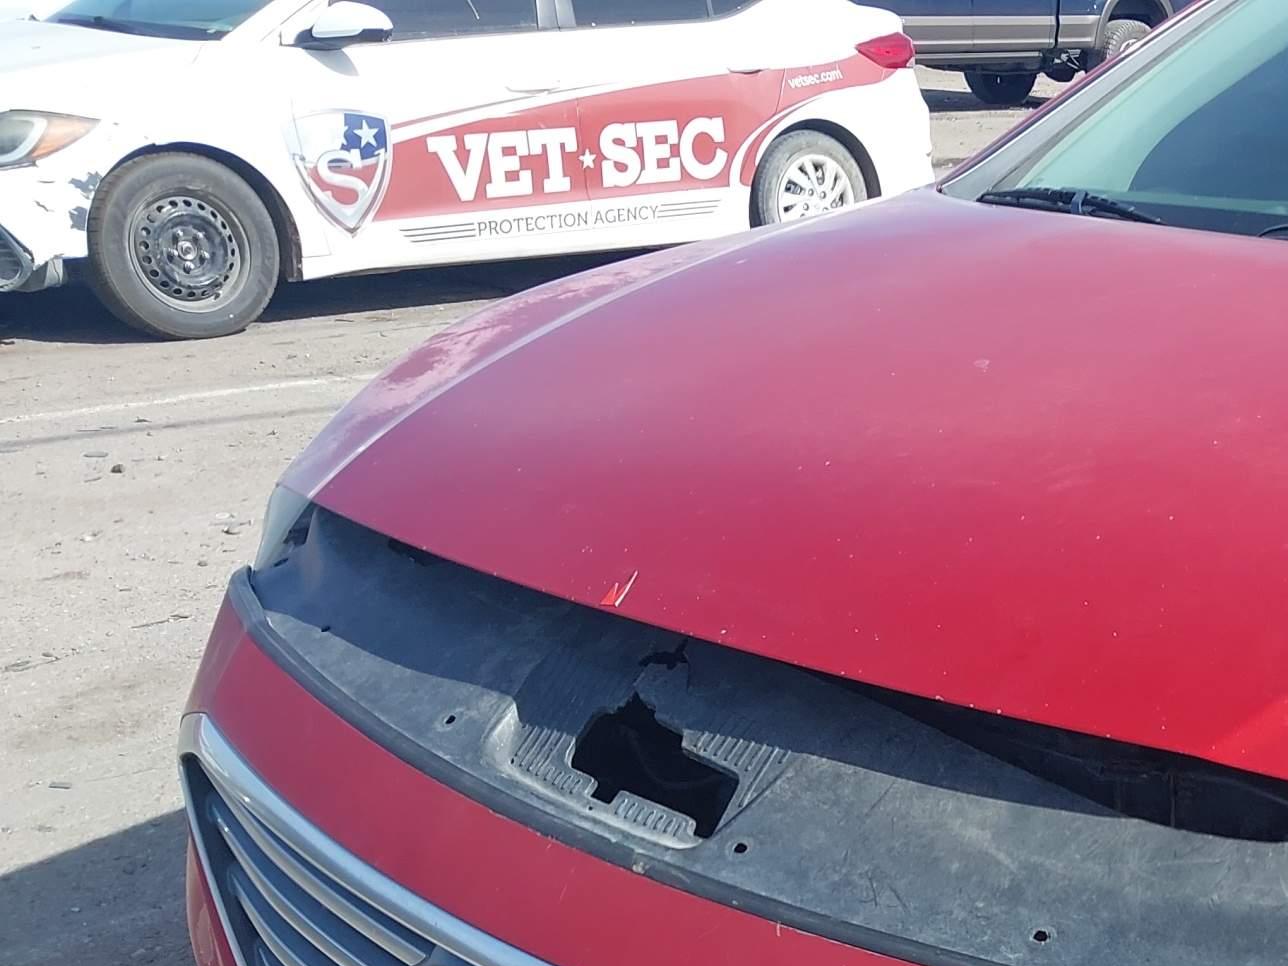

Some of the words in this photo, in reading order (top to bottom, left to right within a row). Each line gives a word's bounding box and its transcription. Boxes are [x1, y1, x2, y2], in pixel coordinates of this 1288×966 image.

[787, 69, 844, 89] vetsec.com
[425, 126, 578, 202] VET
[599, 116, 729, 188] SEC
[476, 211, 589, 237] PROTECTION
[594, 204, 659, 226] AGENCY
